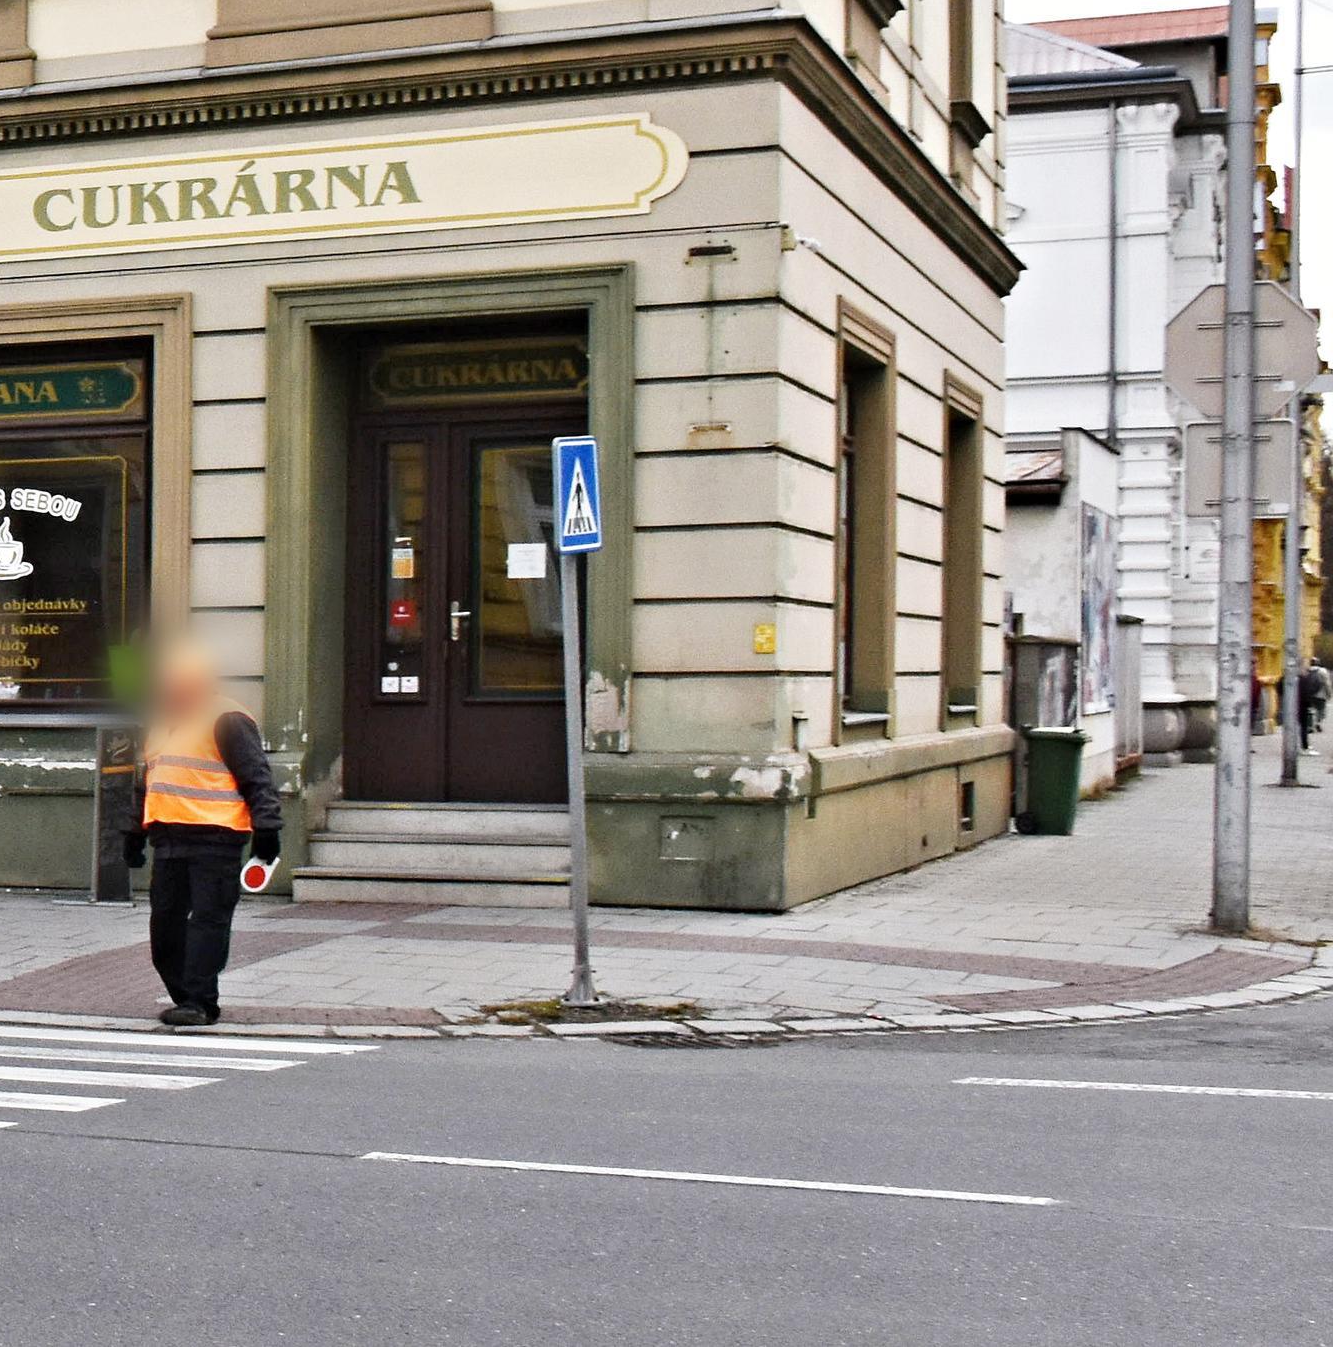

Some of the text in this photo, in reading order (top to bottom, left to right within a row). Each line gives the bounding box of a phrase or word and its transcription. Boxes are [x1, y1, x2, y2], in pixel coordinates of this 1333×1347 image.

[33, 160, 421, 232] CUKRÁRNA
[10, 488, 82, 522] SEBOU
[3, 597, 86, 613] objednávky
[11, 623, 59, 635] koláče
